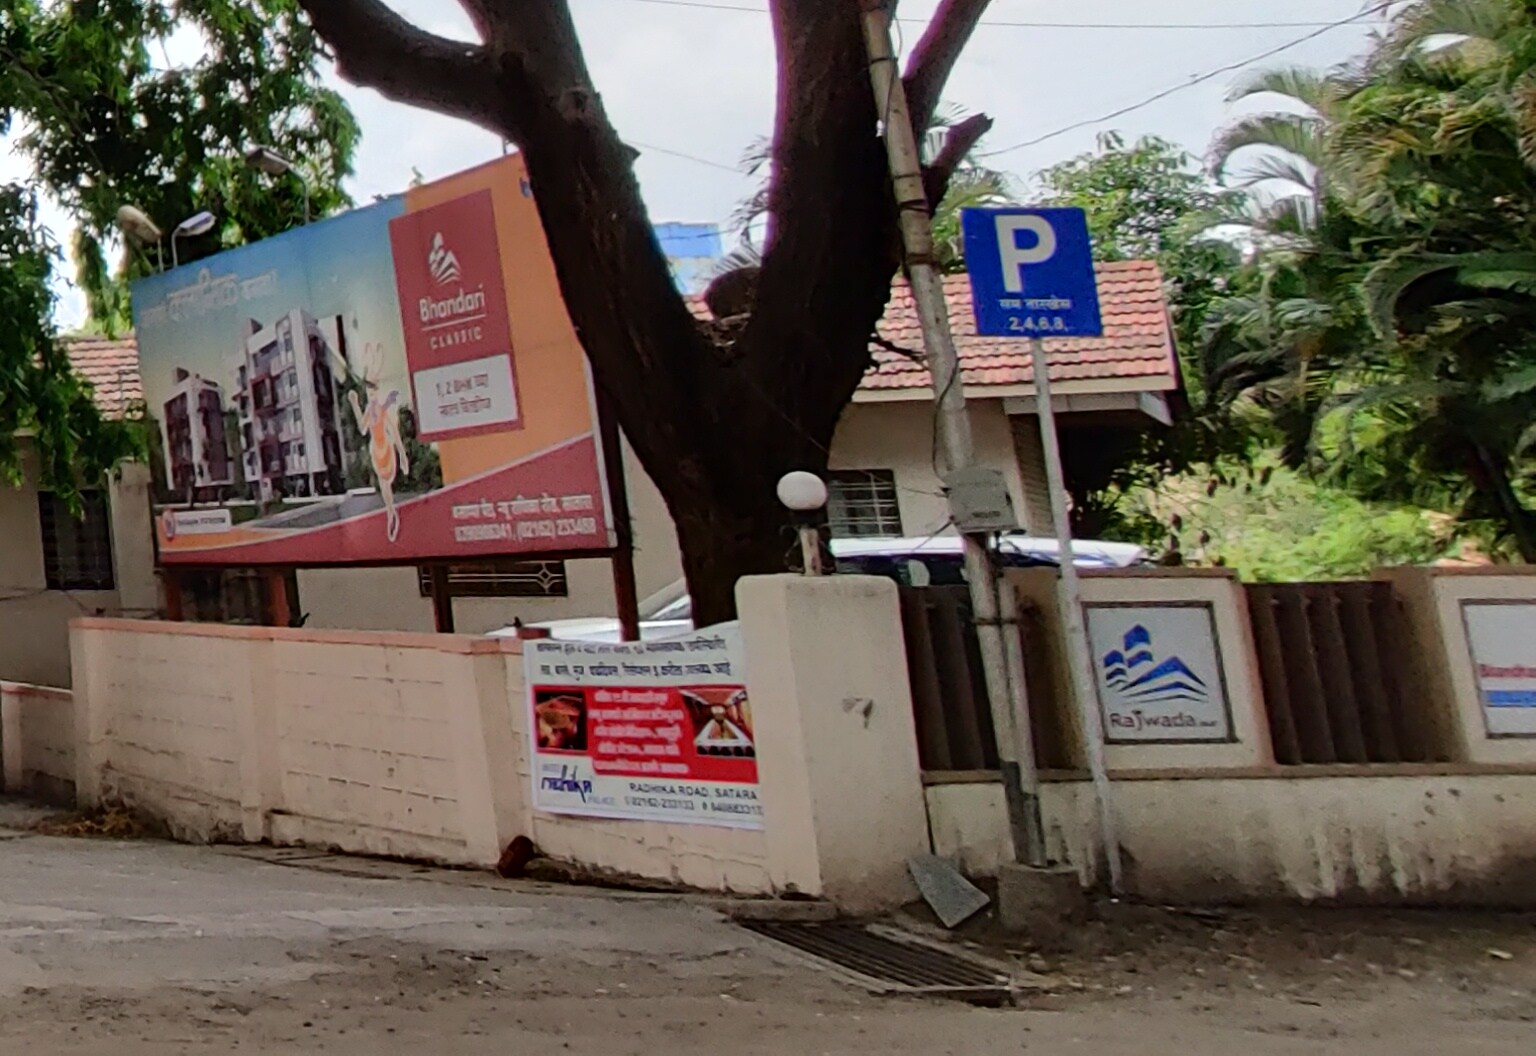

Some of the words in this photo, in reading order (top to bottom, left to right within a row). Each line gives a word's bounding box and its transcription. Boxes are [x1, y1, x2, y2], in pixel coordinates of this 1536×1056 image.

[994, 215, 1057, 293] P
[419, 283, 485, 321] Bhandari
[1110, 710, 1196, 731] Rajwada
[630, 782, 676, 795] RADHIKA
[715, 788, 758, 800] SATARA
